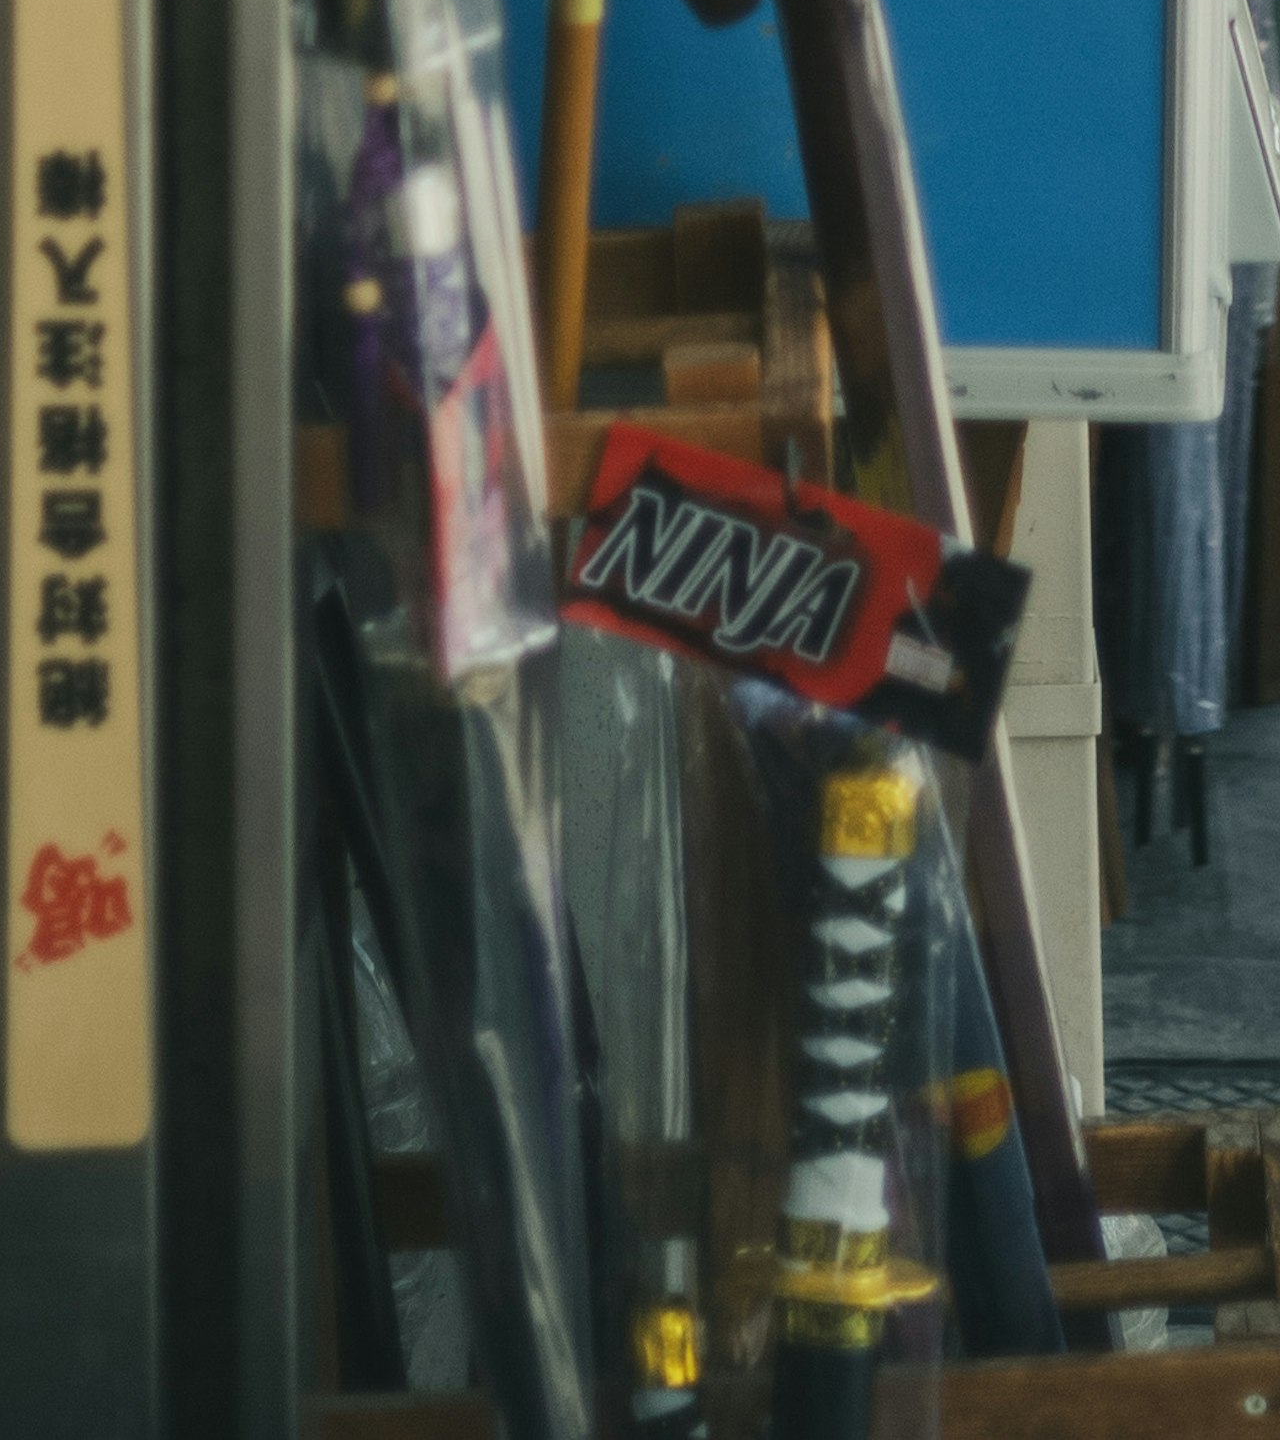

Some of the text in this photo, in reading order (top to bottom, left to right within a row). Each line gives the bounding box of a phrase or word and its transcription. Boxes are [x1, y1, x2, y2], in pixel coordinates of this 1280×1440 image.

[34, 147, 111, 731] 絶対合格注入棒
[578, 487, 860, 664] NINJA
